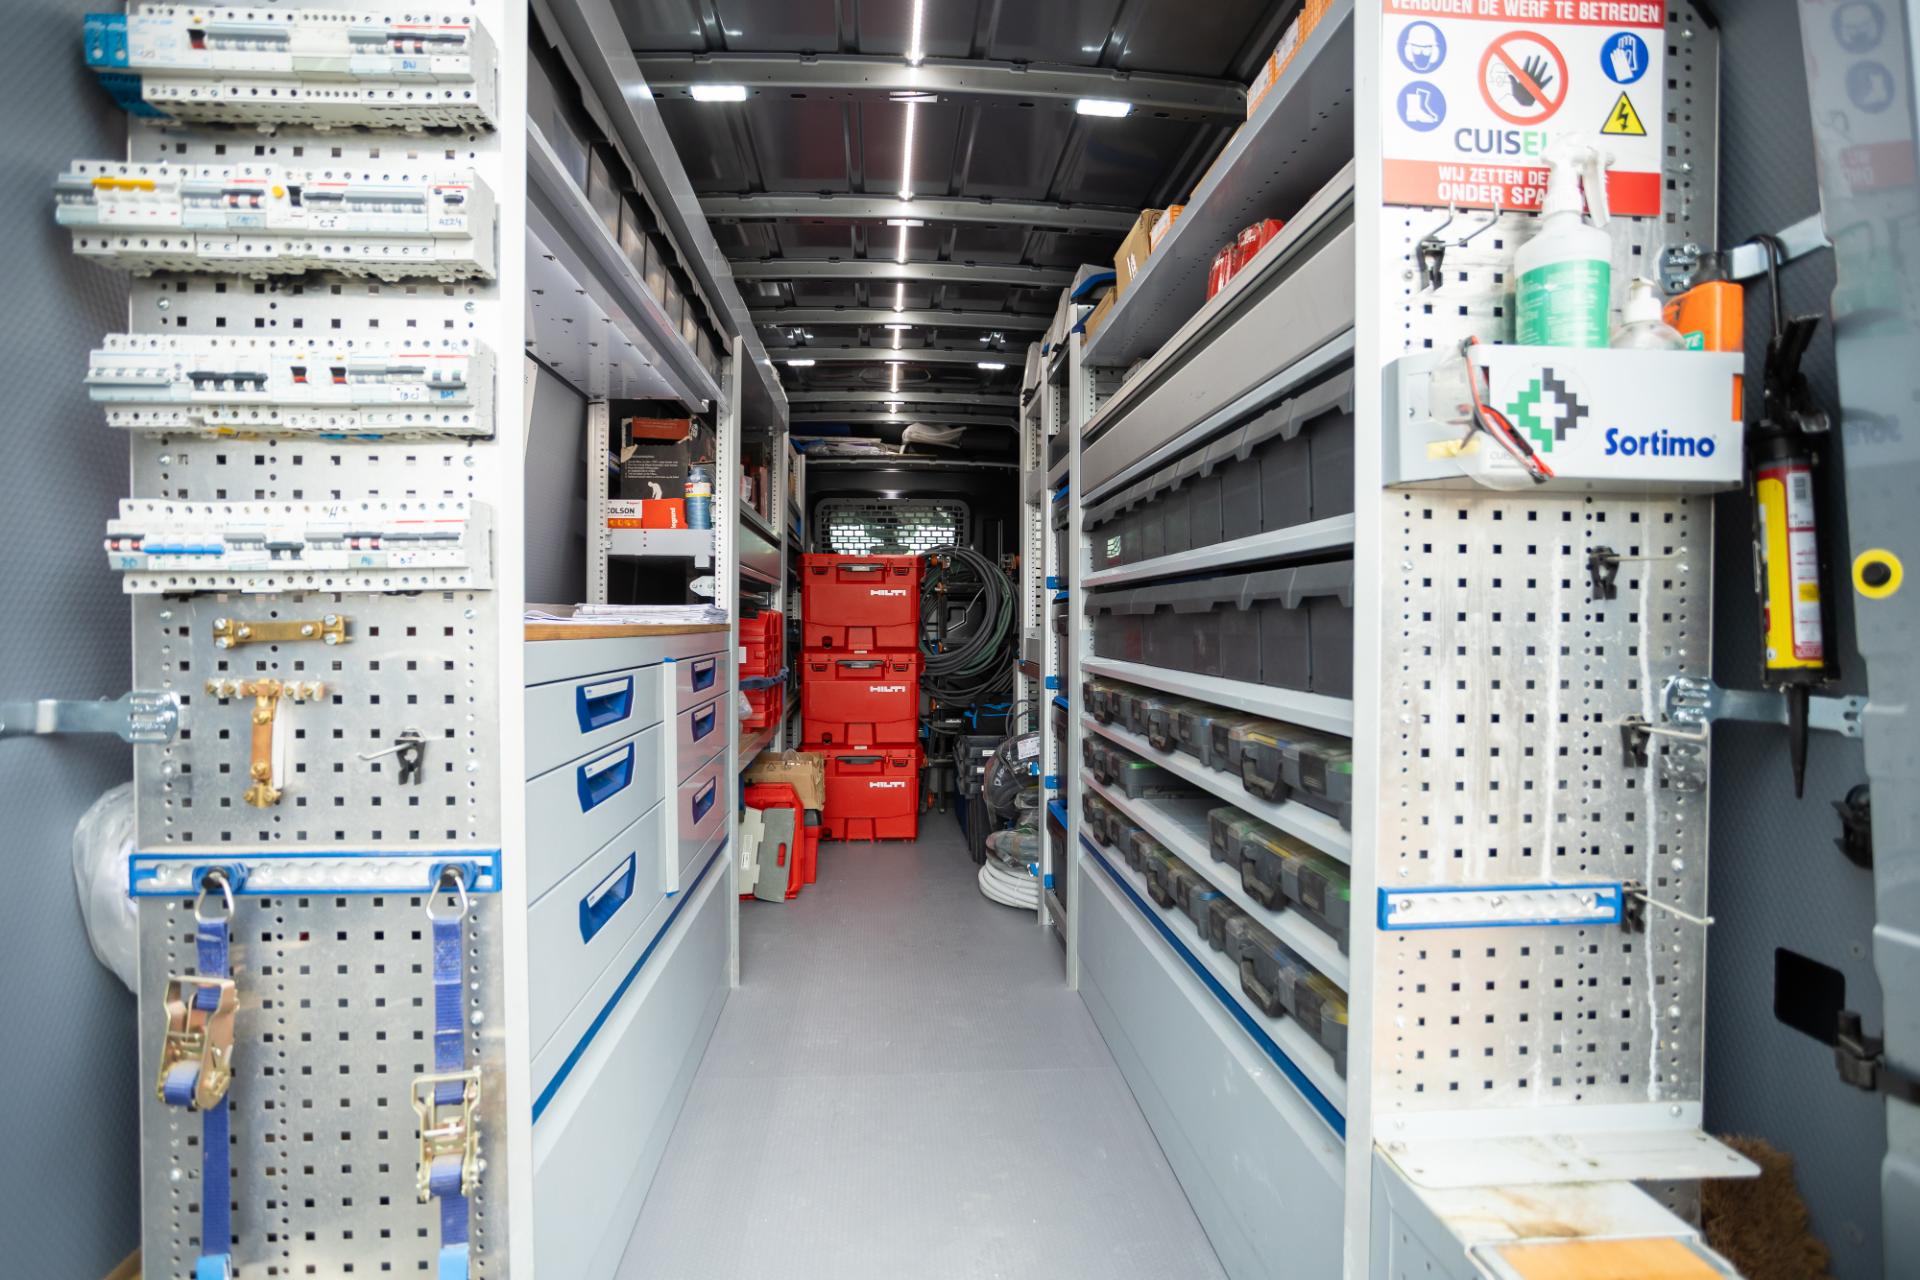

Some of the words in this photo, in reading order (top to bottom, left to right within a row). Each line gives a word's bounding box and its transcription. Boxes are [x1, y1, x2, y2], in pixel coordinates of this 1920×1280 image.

[1390, 0, 1473, 13] VERBODEN
[1478, 0, 1499, 16] DE
[1504, 0, 1549, 18] WERF
[1555, 2, 1574, 20] TE
[1579, 3, 1660, 23] BETREDEN
[1438, 166, 1463, 182] WIJ
[1470, 168, 1523, 185] ZETTEN
[1437, 182, 1505, 204] ONDER
[1511, 186, 1547, 206] SPA
[1605, 427, 1715, 458] Sortimo
[870, 685, 906, 693] HILTI
